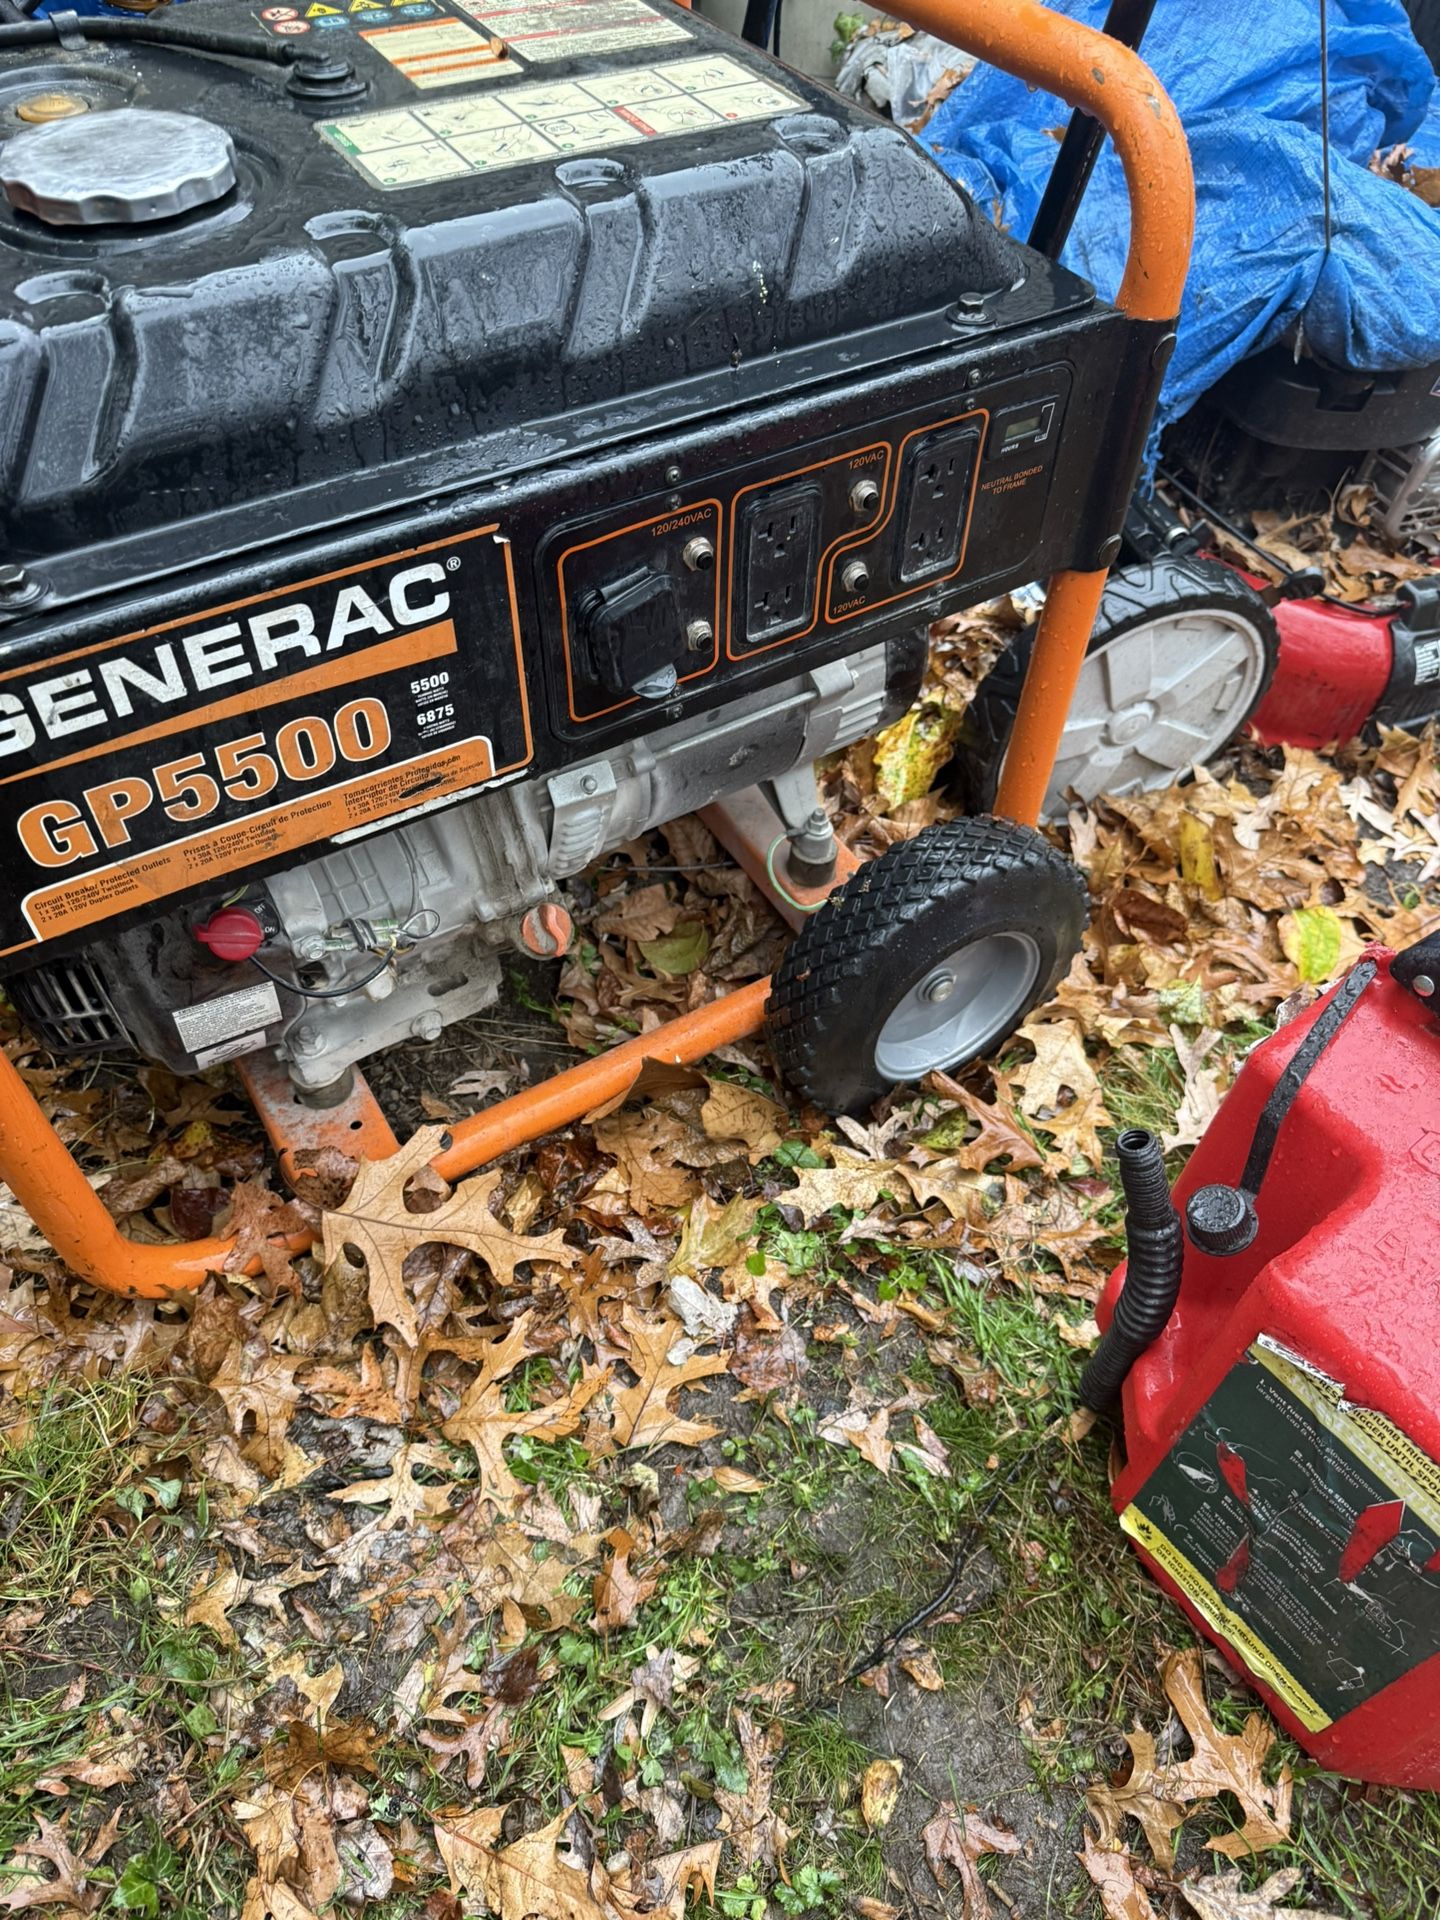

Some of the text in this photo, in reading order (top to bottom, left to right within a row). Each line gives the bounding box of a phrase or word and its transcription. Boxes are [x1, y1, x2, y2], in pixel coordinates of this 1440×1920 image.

[848, 450, 885, 470] 120VAC
[980, 464, 1043, 490] NEUTRAL BONDED
[991, 485, 1003, 495] TO
[650, 508, 712, 538] 120/240VAC
[832, 596, 866, 615] 120VAC
[410, 671, 449, 694] 5500
[417, 704, 455, 726] 6875
[17, 697, 391, 867] GP5500
[343, 774, 403, 800] Tomacorrientes
[387, 783, 399, 791] de
[399, 772, 429, 787] Circuito
[372, 800, 388, 809] 120V
[182, 842, 210, 857] Prises
[277, 813, 289, 823] de
[289, 798, 332, 819] Protection
[214, 849, 231, 860] 120V
[232, 841, 254, 853] Prises
[33, 855, 171, 911] Circuit Breaker Protected Outlets
[66, 889, 100, 906] 120/240V
[101, 877, 134, 893] Twistlock
[69, 901, 88, 912] 120V
[88, 892, 113, 906] Duplex
[114, 882, 139, 896] Outlets
[254, 903, 266, 914] OFF
[264, 926, 275, 934] ON
[1254, 1384, 1276, 1405] large
[1274, 1402, 1286, 1414] fill
[1284, 1413, 1300, 1429] cap
[1267, 1386, 1290, 1408] Vent
[1286, 1403, 1304, 1422] fuel
[1302, 1420, 1317, 1436] can
[1386, 1440, 1415, 1470] UNTIL
[1305, 1461, 1333, 1494] Remove
[1155, 1547, 1167, 1560] OR
[1166, 1559, 1200, 1597] IGNITION
[1159, 1543, 1171, 1556] DO
[1170, 1555, 1188, 1573] NOT
[1187, 1573, 1210, 1598] POUR
[1208, 1597, 1221, 1611] ON
[1231, 1622, 1266, 1660] AROUND
[1308, 1584, 1338, 1615] release
